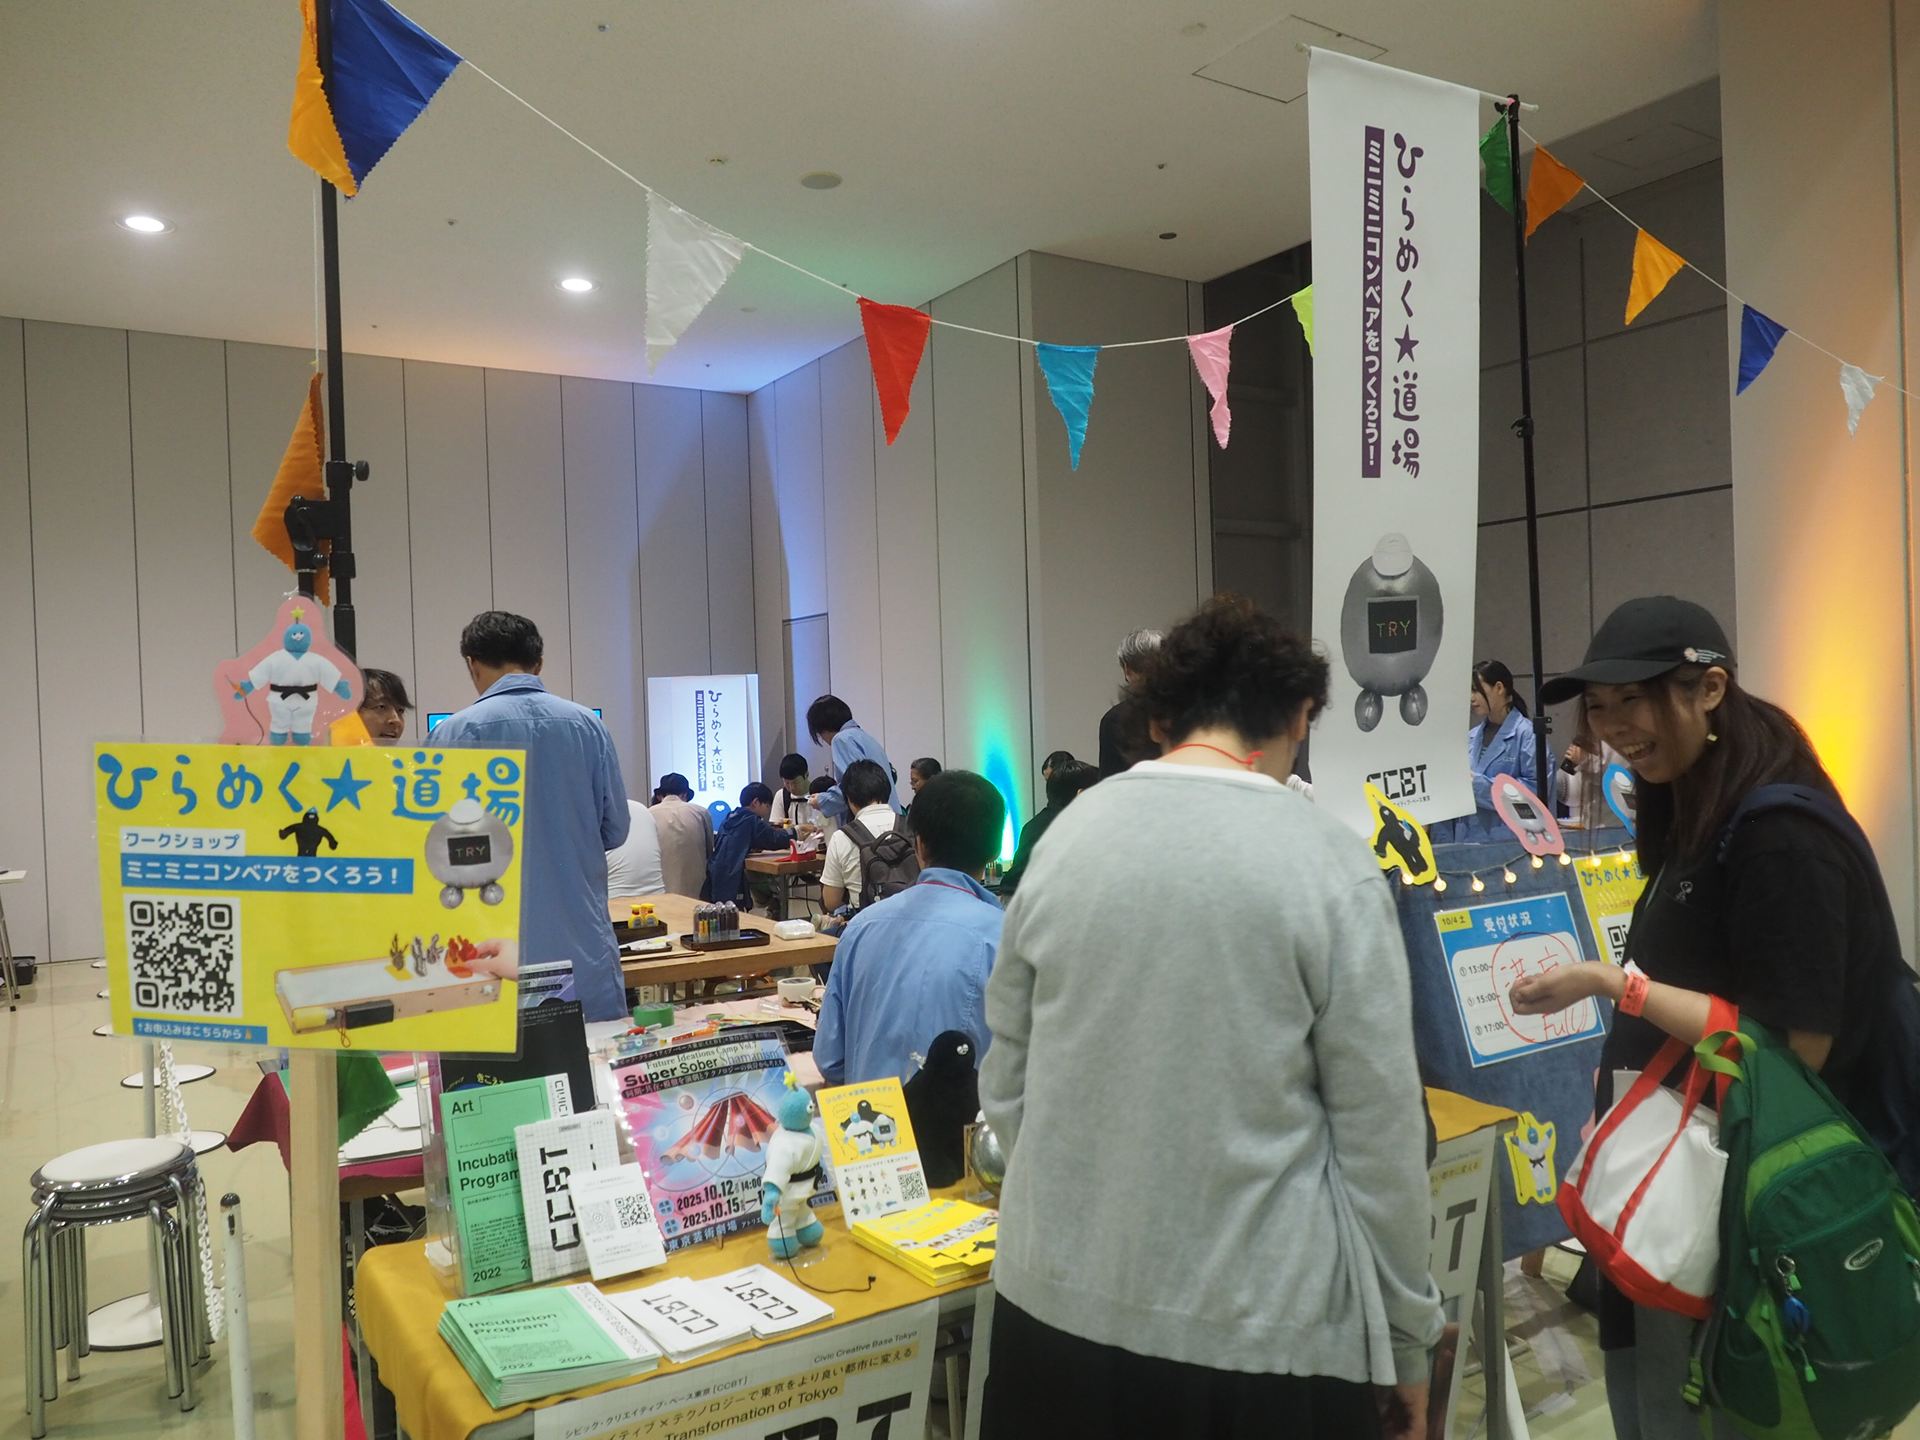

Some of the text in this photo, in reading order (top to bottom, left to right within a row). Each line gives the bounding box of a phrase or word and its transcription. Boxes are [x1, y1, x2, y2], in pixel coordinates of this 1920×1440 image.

[1392, 132, 1424, 479] ひらめく★道場
[1376, 619, 1411, 638] TRY
[97, 752, 520, 826] ひらめく★道場
[125, 832, 240, 850] ワークショップ
[455, 844, 487, 858] TRY
[1483, 911, 1533, 934] 受付状況
[1476, 992, 1497, 1004] 15:00
[144, 1022, 242, 1040] お申込みはこちらから
[1483, 1021, 1505, 1033] 17:00
[623, 1048, 780, 1087] Super Sober Shamanism
[646, 1057, 676, 1070] Future
[677, 1048, 716, 1063] Ideations
[716, 1043, 739, 1056] Camp
[452, 1099, 474, 1115] Art
[458, 1149, 518, 1173] Incubati
[460, 1168, 520, 1191] Program
[539, 1147, 581, 1252] CCBT
[676, 1180, 735, 1211] 2025.10.12
[741, 1177, 762, 1192] 14:00
[682, 1197, 741, 1229] 2025.10.15
[473, 1266, 502, 1283] 2022
[456, 1299, 482, 1309] Art
[724, 1281, 798, 1320] CCBT
[468, 1312, 558, 1329] Incubation
[642, 1294, 719, 1334] CCBT
[472, 1322, 550, 1336] Program
[814, 1330, 918, 1364] Civic Creative Base Tokyo
[499, 1354, 593, 1372] 2022 2024
[778, 1397, 793, 1411] of
[798, 1384, 839, 1407] Tokyo
